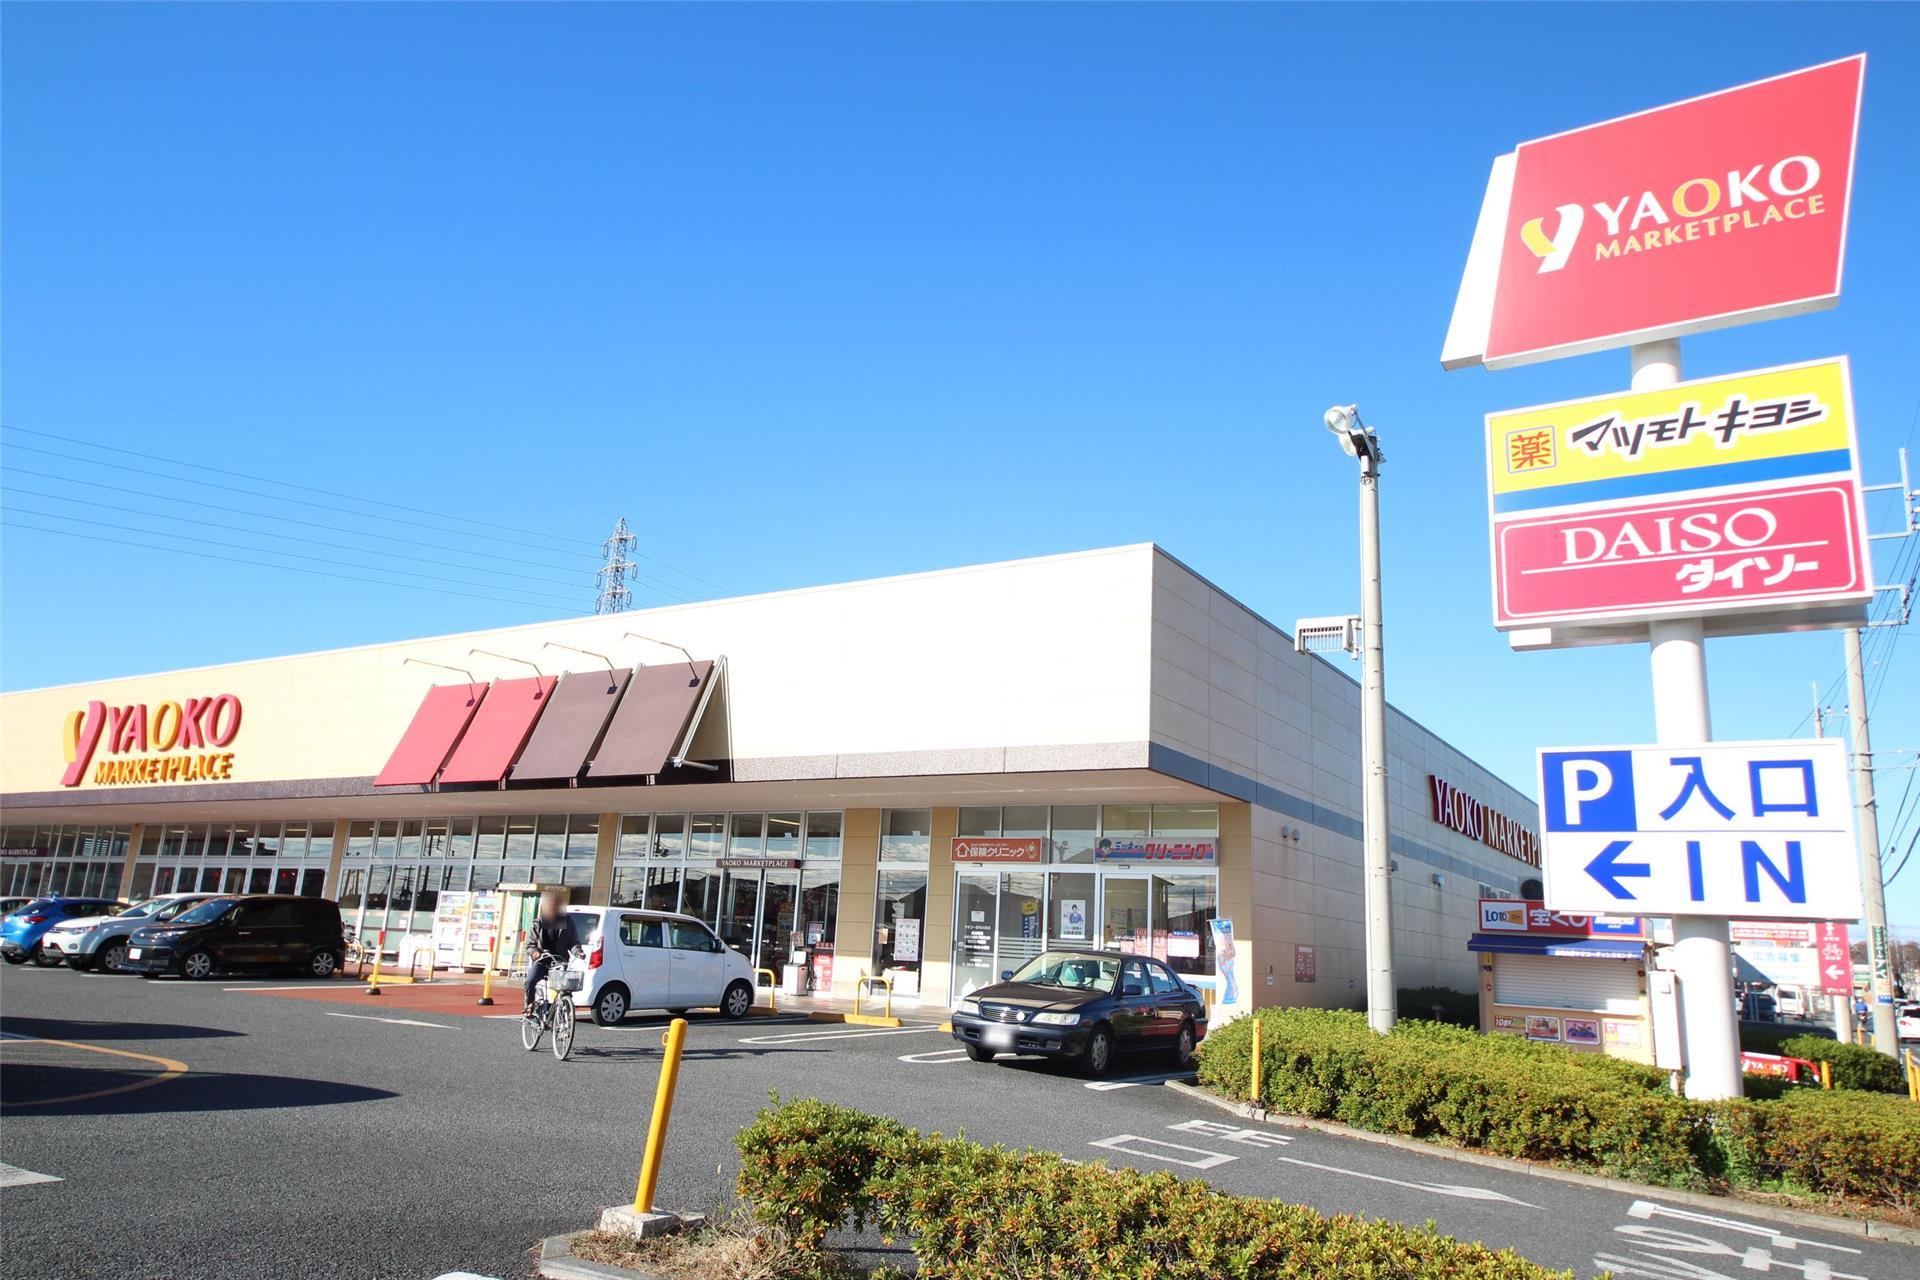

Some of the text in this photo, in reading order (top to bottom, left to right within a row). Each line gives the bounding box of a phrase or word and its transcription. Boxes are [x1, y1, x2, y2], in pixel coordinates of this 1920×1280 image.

[1592, 155, 1821, 236] YAOKO
[1594, 194, 1826, 261] MARKETPLACE
[1511, 430, 1552, 470] 薬
[1571, 400, 1823, 456] マツモトキヨシ
[1561, 507, 1777, 565] DAISO
[1675, 553, 1820, 594] ダイソー
[107, 693, 242, 755] YAOKO
[93, 752, 235, 785] MARKETPLACE
[1562, 759, 1613, 826] P
[1658, 756, 1819, 822] 入口
[969, 847, 1025, 857] 保険クリニック
[1429, 774, 1542, 870] YAOKO MARKETPL
[1686, 840, 1806, 904] IN
